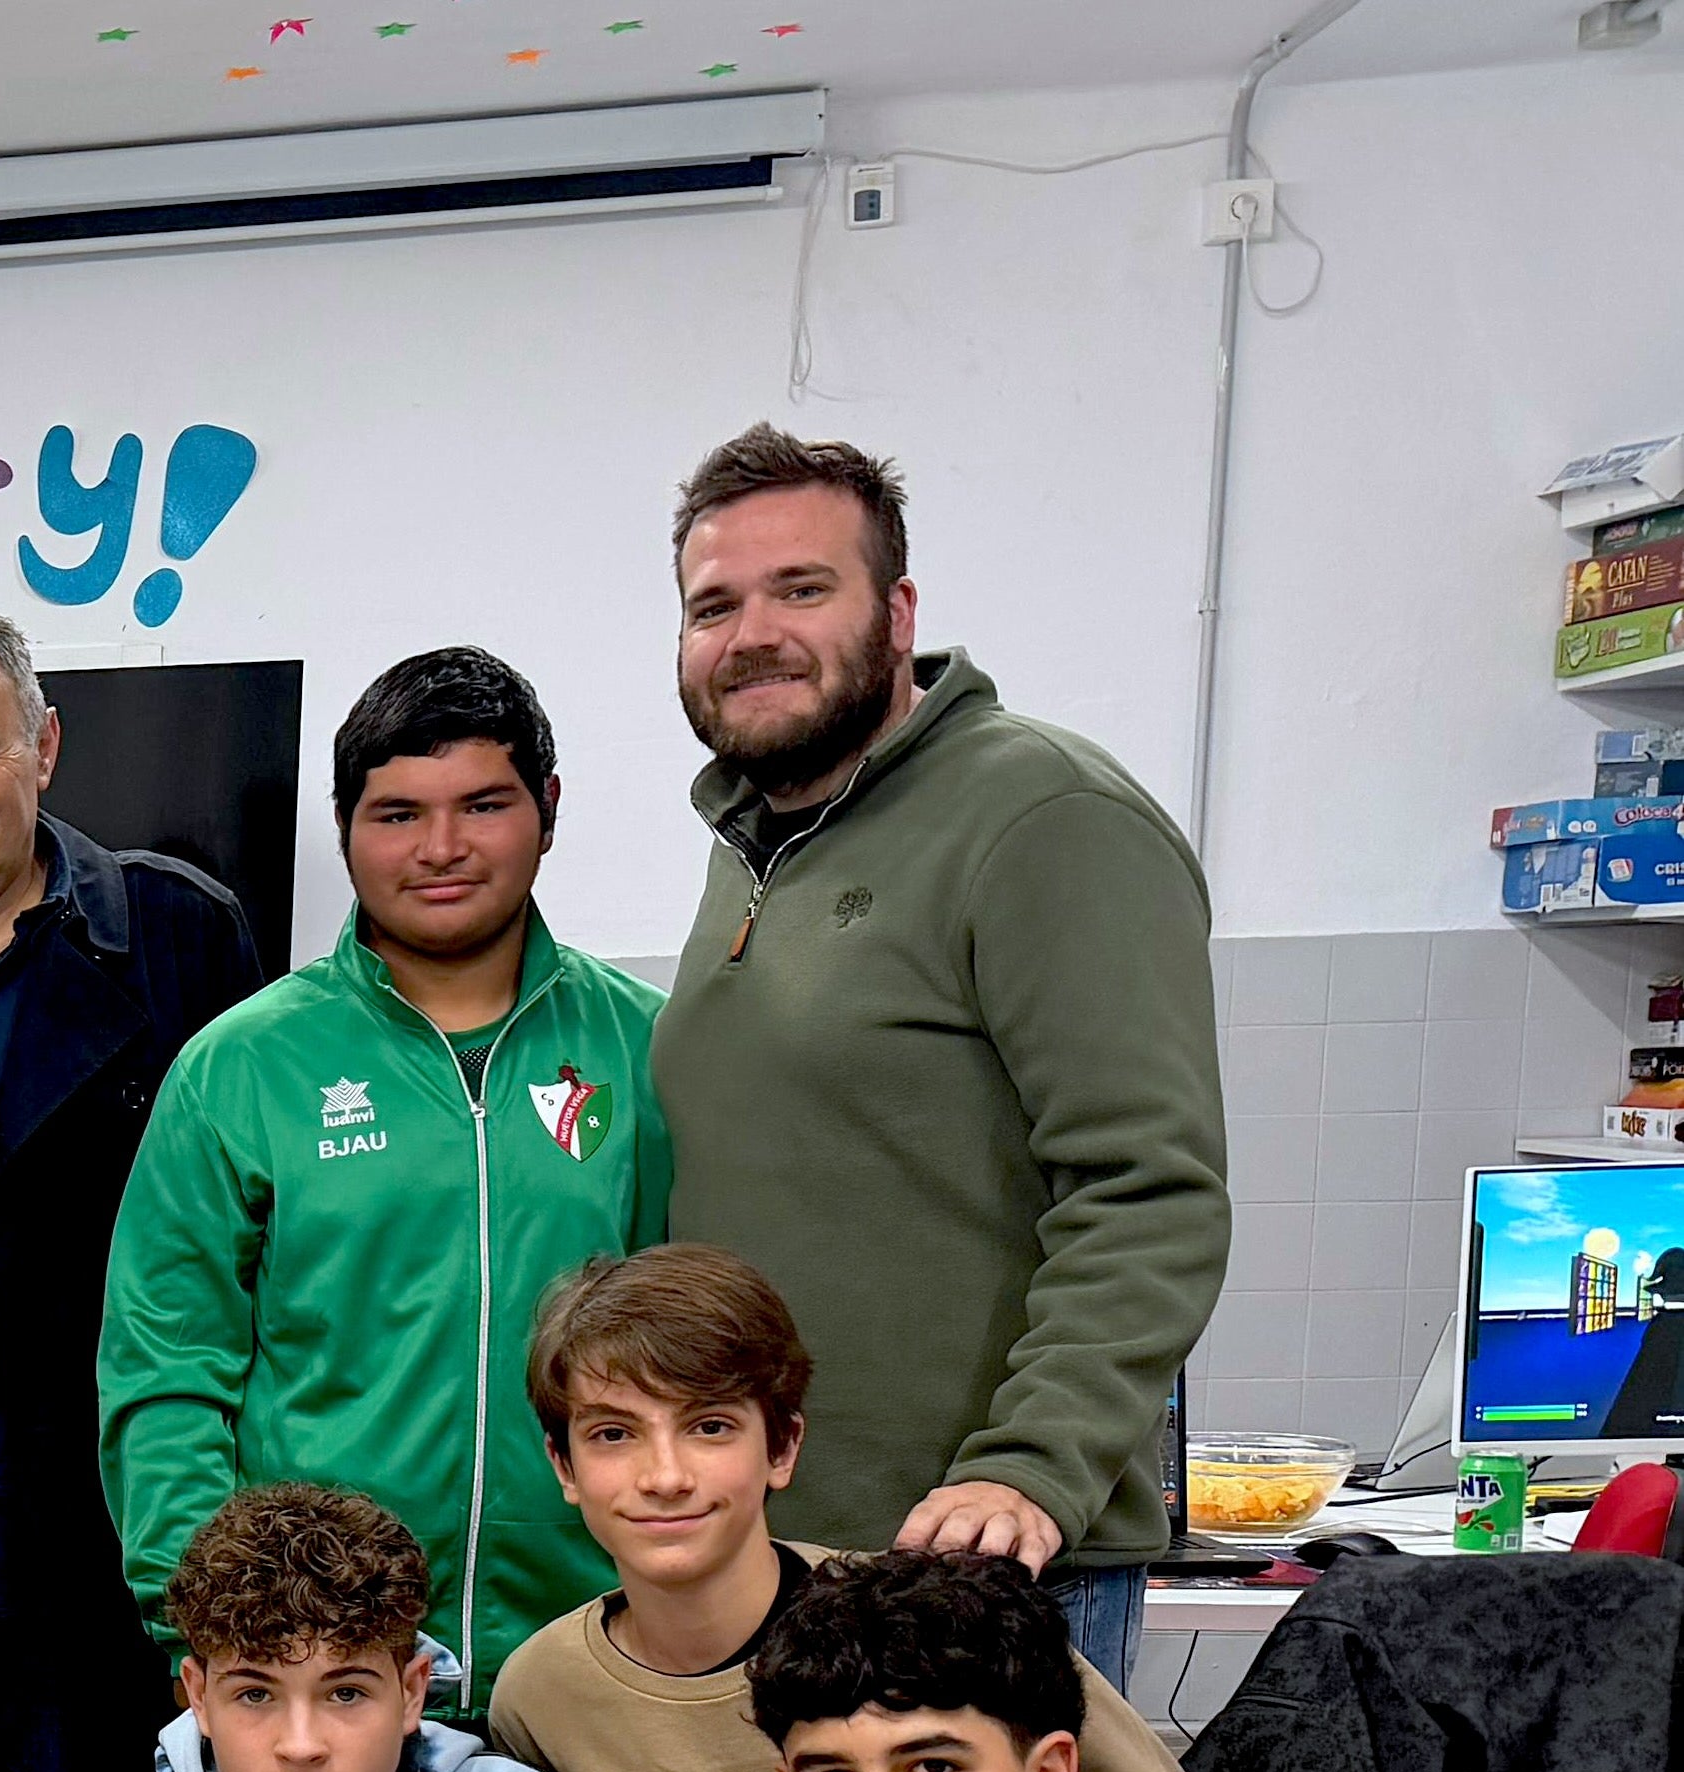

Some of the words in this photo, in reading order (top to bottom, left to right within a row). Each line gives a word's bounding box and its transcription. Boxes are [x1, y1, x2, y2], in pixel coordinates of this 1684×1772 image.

[1608, 555, 1648, 587] CATAN
[323, 1107, 375, 1128] luanvi
[318, 1131, 387, 1159] BJAU
[1461, 1474, 1501, 1497] NTA
